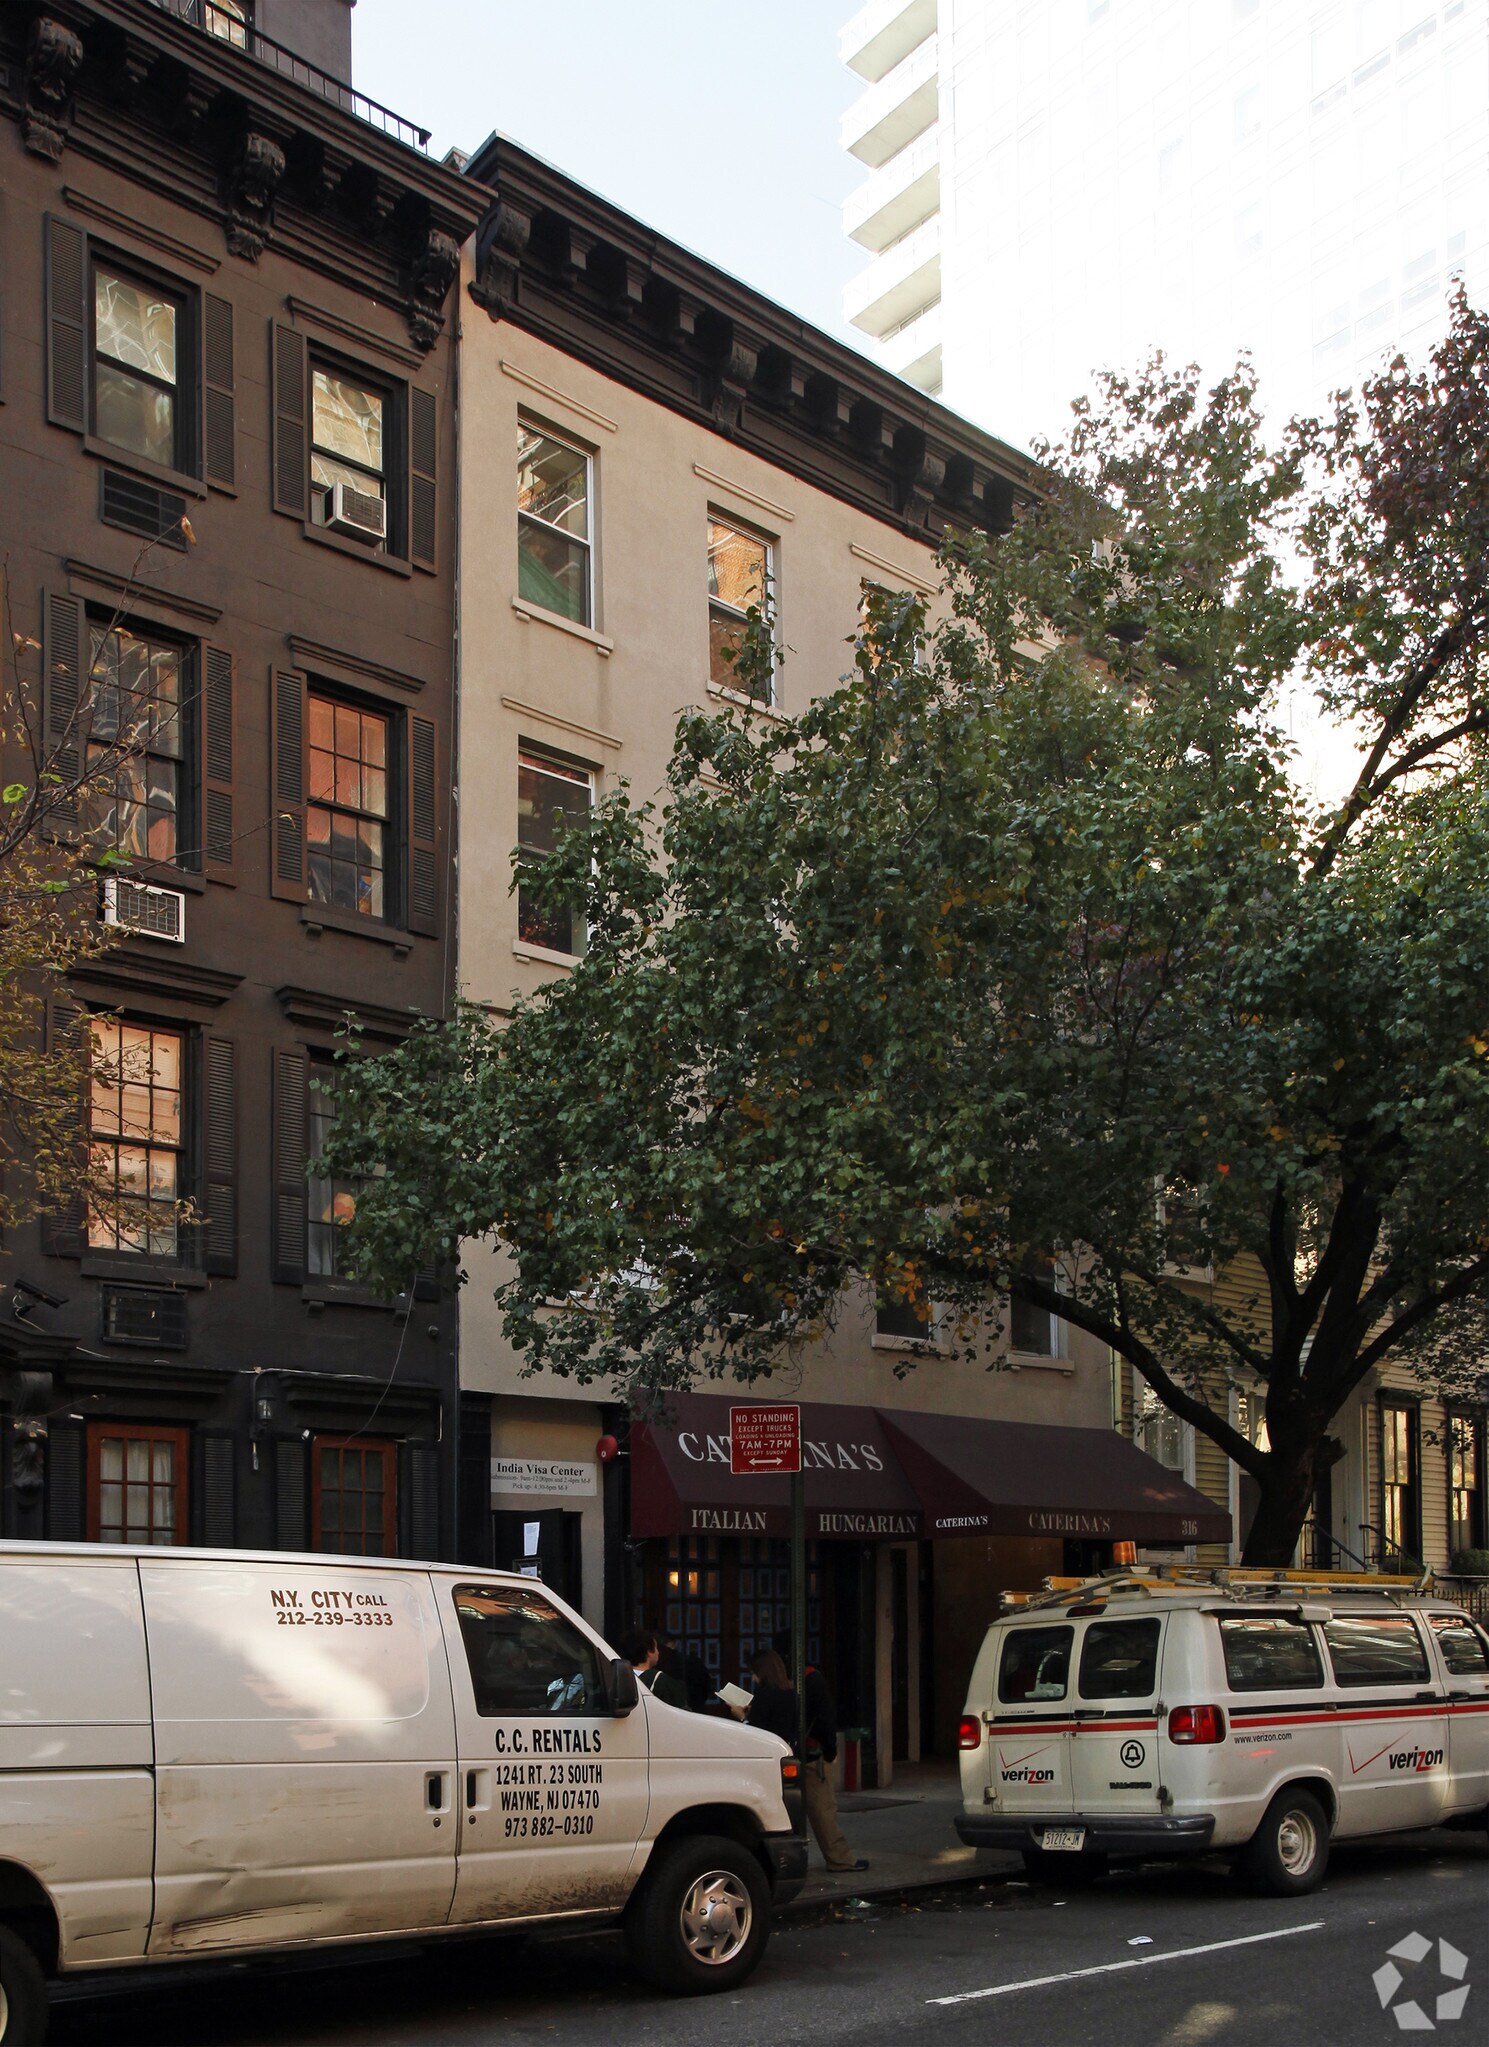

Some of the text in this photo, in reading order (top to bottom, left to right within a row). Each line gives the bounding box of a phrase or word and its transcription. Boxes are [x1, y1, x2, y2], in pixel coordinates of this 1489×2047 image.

[735, 1413, 794, 1423] NO STANDING
[766, 1424, 792, 1432] TRUCKS
[678, 1432, 884, 1472] CATNA'S
[739, 1439, 792, 1449] 7AM-7PM
[496, 1462, 584, 1476] India Visa Center
[512, 1482, 523, 1490] Pick
[691, 1508, 768, 1530] ITALIAN
[818, 1513, 917, 1534] HUNGARIAN
[935, 1515, 989, 1529] CATERINA'S
[1028, 1512, 1111, 1533] CATERINA'S
[1181, 1519, 1198, 1536] 316
[270, 1590, 388, 1609] N.Y. CITY CALL
[276, 1611, 393, 1626] 212-239-3333
[495, 1728, 602, 1753] C.C. RENTALS
[1233, 1732, 1293, 1744] www.verizon.com
[1387, 1745, 1445, 1773] verizon
[496, 1764, 602, 1785] 1241 RT. 23 SOUTH
[1001, 1766, 1055, 1785] verizon
[501, 1789, 600, 1814] WAYNE, NJ 07470
[504, 1815, 594, 1837] 973 882-0310
